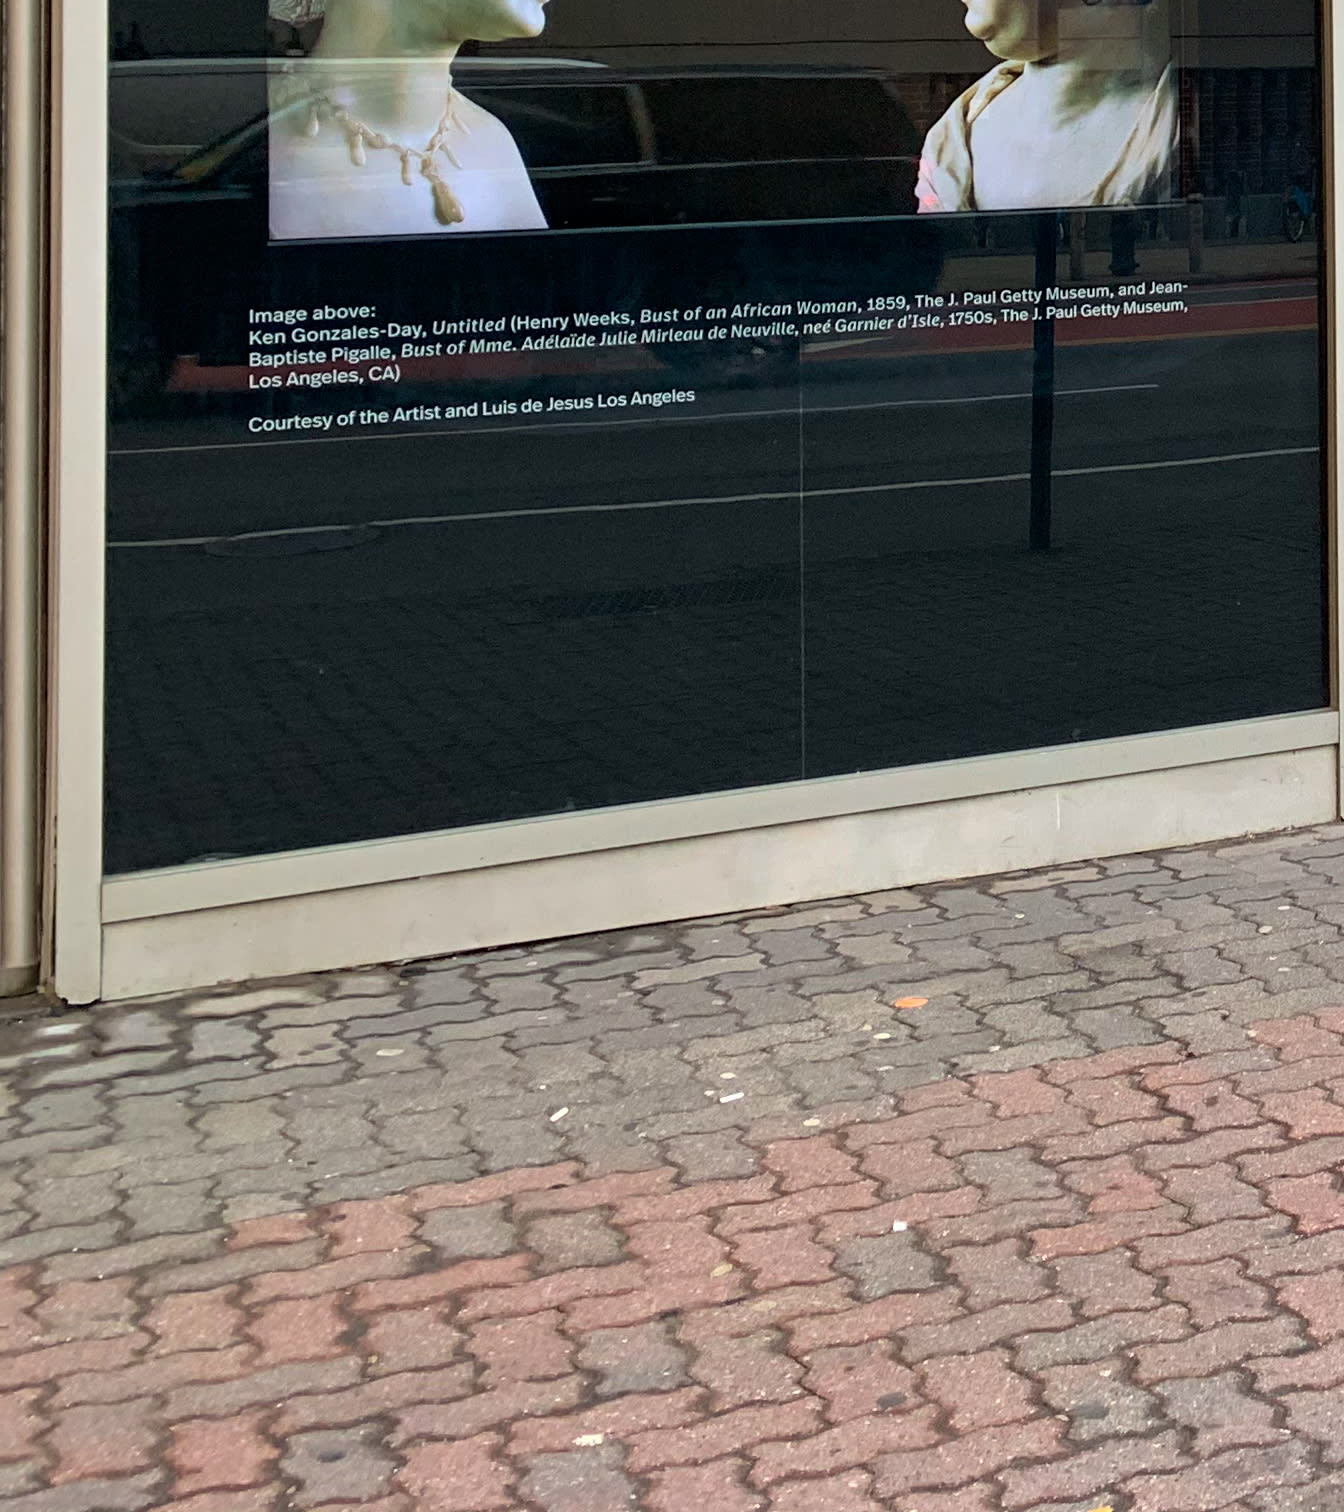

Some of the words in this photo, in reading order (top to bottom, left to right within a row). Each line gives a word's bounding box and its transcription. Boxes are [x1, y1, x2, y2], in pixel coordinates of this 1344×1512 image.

[249, 328, 286, 344] Ken
[291, 320, 426, 346] Gonzales-Day,
[432, 316, 505, 334] Untitled
[510, 312, 568, 334] (Henry
[573, 309, 634, 329] Weeks,
[640, 306, 678, 322] Bust
[683, 305, 701, 320] of
[705, 308, 726, 319] an
[730, 300, 792, 317] African
[796, 296, 862, 316] Woman,
[866, 293, 910, 312] 1859,
[914, 292, 944, 307] The
[947, 291, 958, 305] J.
[963, 289, 996, 304] Paul
[998, 286, 1042, 307] Getty
[1046, 282, 1114, 302] Museum,
[1117, 280, 1145, 296] and
[1148, 278, 1188, 294] Jean-
[249, 305, 307, 327] Image
[312, 302, 375, 319] above:
[249, 348, 326, 370] Baptiste
[331, 343, 396, 366] Pigalle,
[401, 341, 442, 357] Bust
[446, 339, 465, 354] of
[468, 336, 518, 353] Mme.
[597, 329, 638, 345] Julie
[638, 325, 703, 343] Mirleau
[707, 324, 727, 339] de
[730, 319, 798, 340] Neuville,
[803, 318, 831, 333] neé
[834, 314, 894, 331] Garnier
[948, 308, 997, 327] 1750s,
[1003, 306, 1028, 321] The
[1030, 305, 1042, 320] J.
[1046, 303, 1077, 319] Paul
[1080, 300, 1121, 321] Getty
[1123, 296, 1188, 317] Museum,
[249, 371, 282, 386] Los
[286, 368, 363, 389] Angeles,
[368, 367, 400, 384] CA)
[248, 411, 333, 435] Courtesy
[336, 410, 356, 425] of
[359, 407, 389, 423] the
[392, 404, 441, 421] Artist
[444, 401, 478, 417] and
[482, 399, 517, 415] Luis
[520, 397, 542, 412] de
[546, 393, 593, 410] Jesus
[597, 391, 627, 407] Los
[630, 386, 695, 409] Angeles
